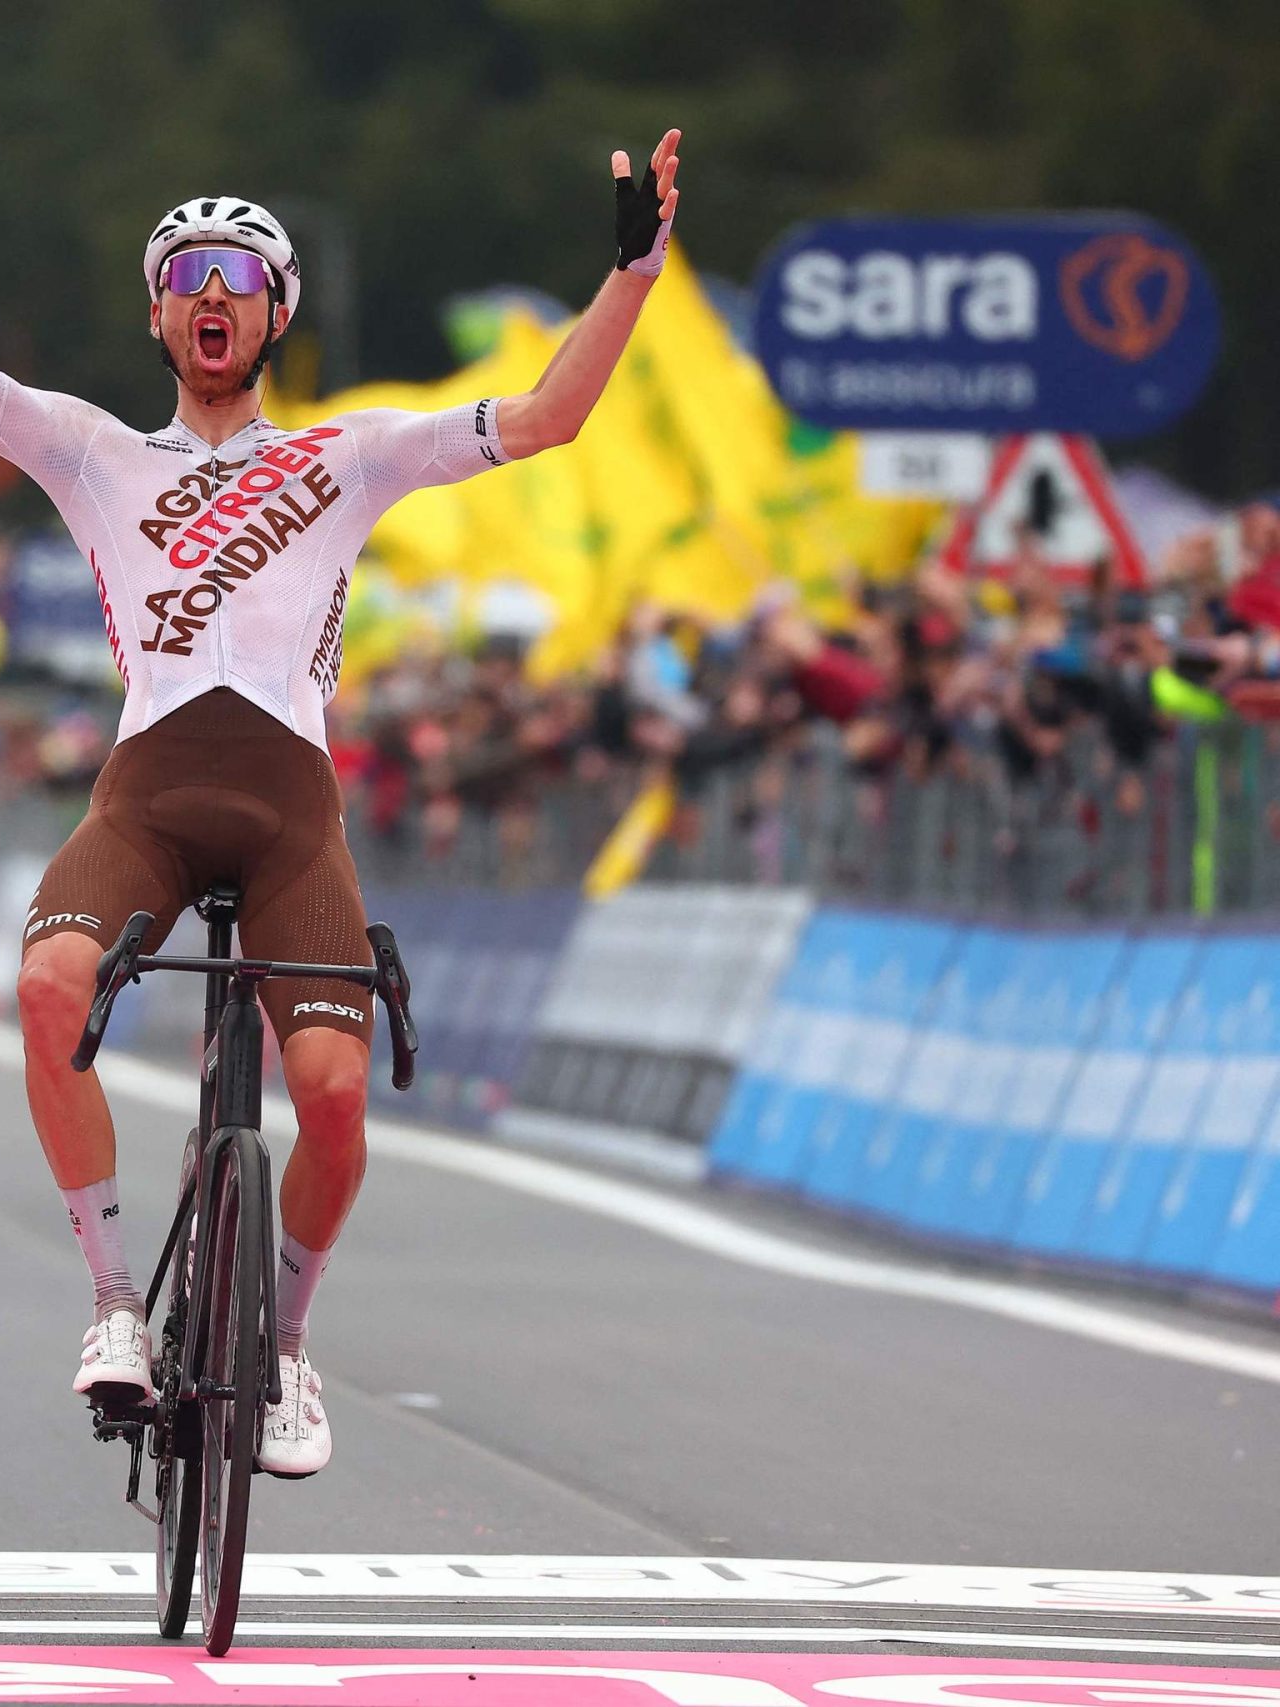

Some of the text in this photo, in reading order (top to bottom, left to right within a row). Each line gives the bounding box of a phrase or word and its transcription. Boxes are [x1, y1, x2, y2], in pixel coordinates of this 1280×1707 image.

[781, 249, 1038, 341] sara
[139, 458, 249, 551] AG2R
[169, 427, 344, 569] CITROËN
[160, 463, 342, 656] MONDIALE
[140, 589, 183, 652] LA
[309, 566, 348, 686] MONDIALE
